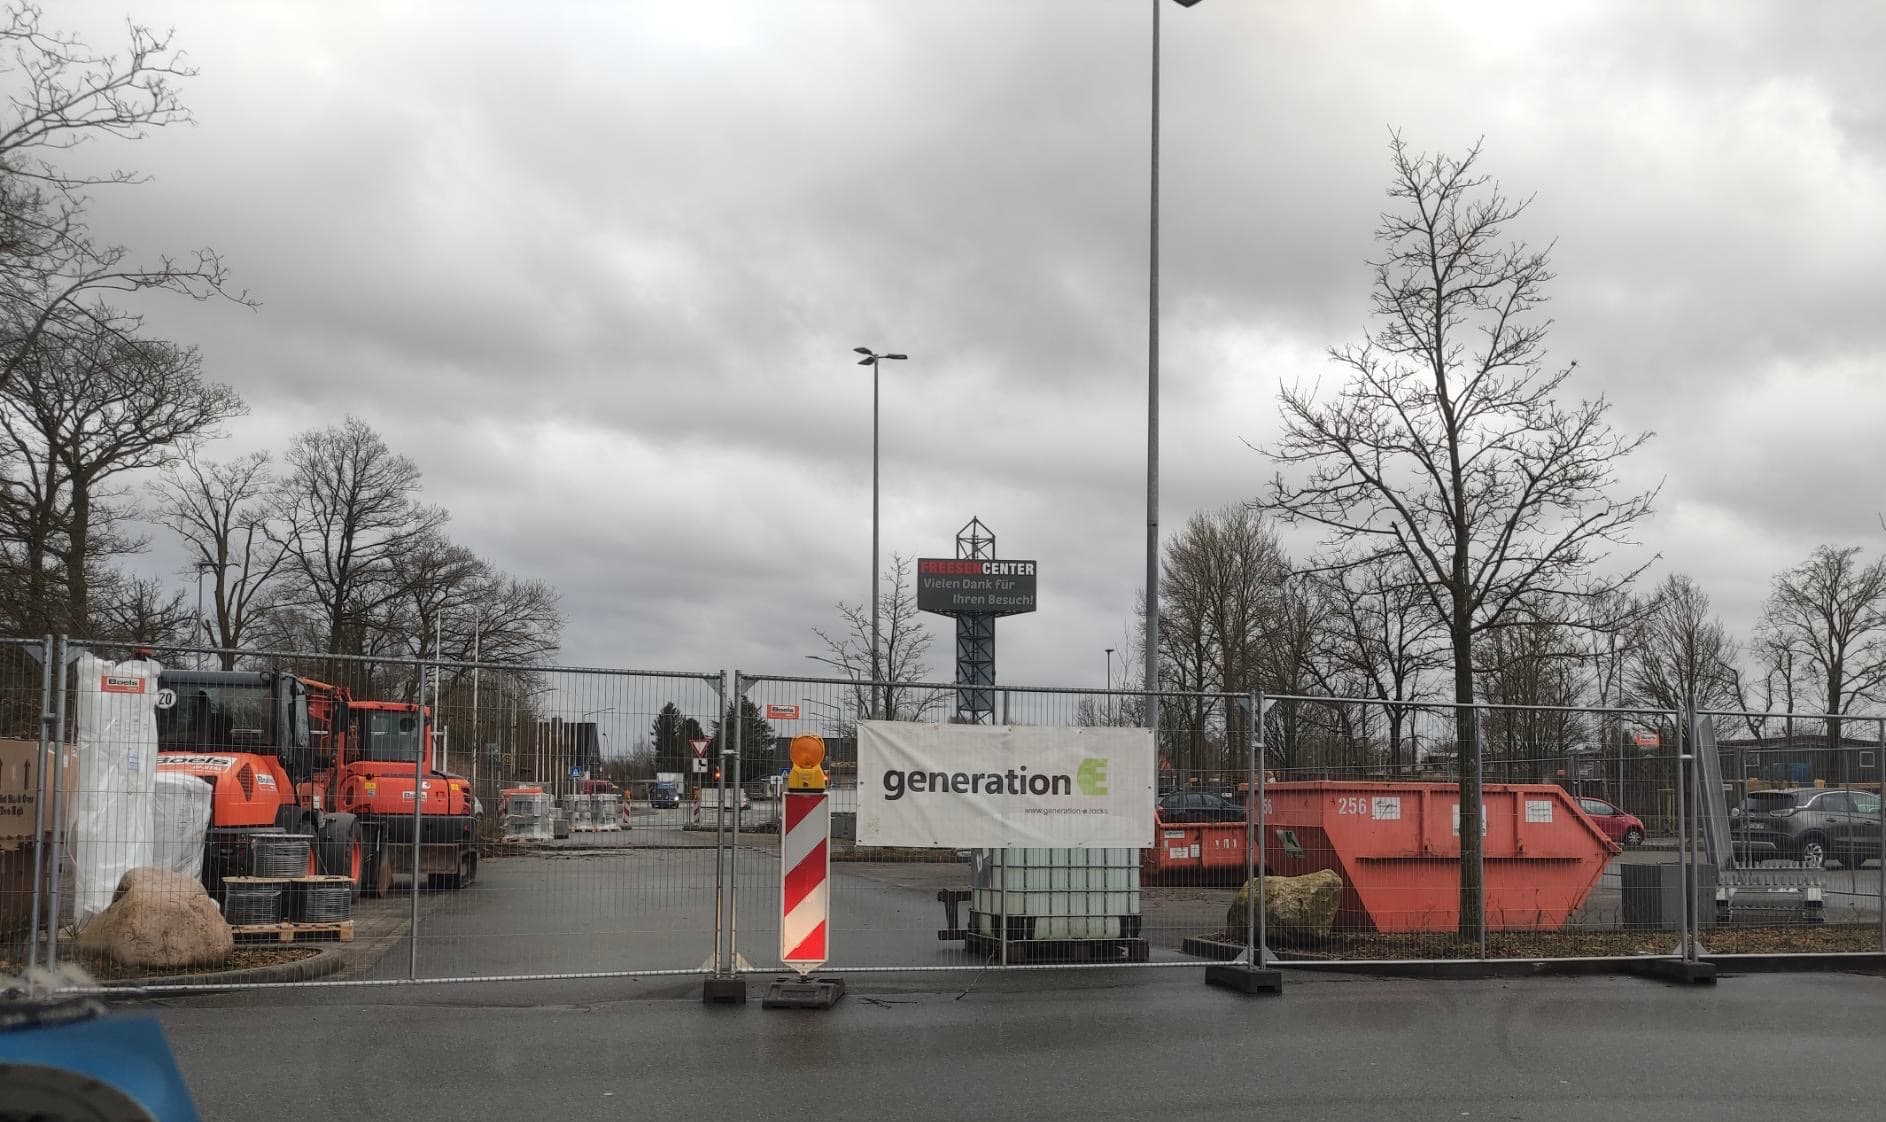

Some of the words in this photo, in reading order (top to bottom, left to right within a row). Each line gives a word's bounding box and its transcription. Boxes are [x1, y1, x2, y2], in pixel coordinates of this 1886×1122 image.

[923, 578, 960, 589] Vielen
[962, 579, 992, 589] Dank
[995, 579, 1015, 590] für
[953, 594, 985, 605] Ihren
[988, 594, 1033, 605] Besuch!
[159, 692, 172, 705] 20
[883, 765, 1071, 800] generation
[1338, 798, 1367, 815] 256
